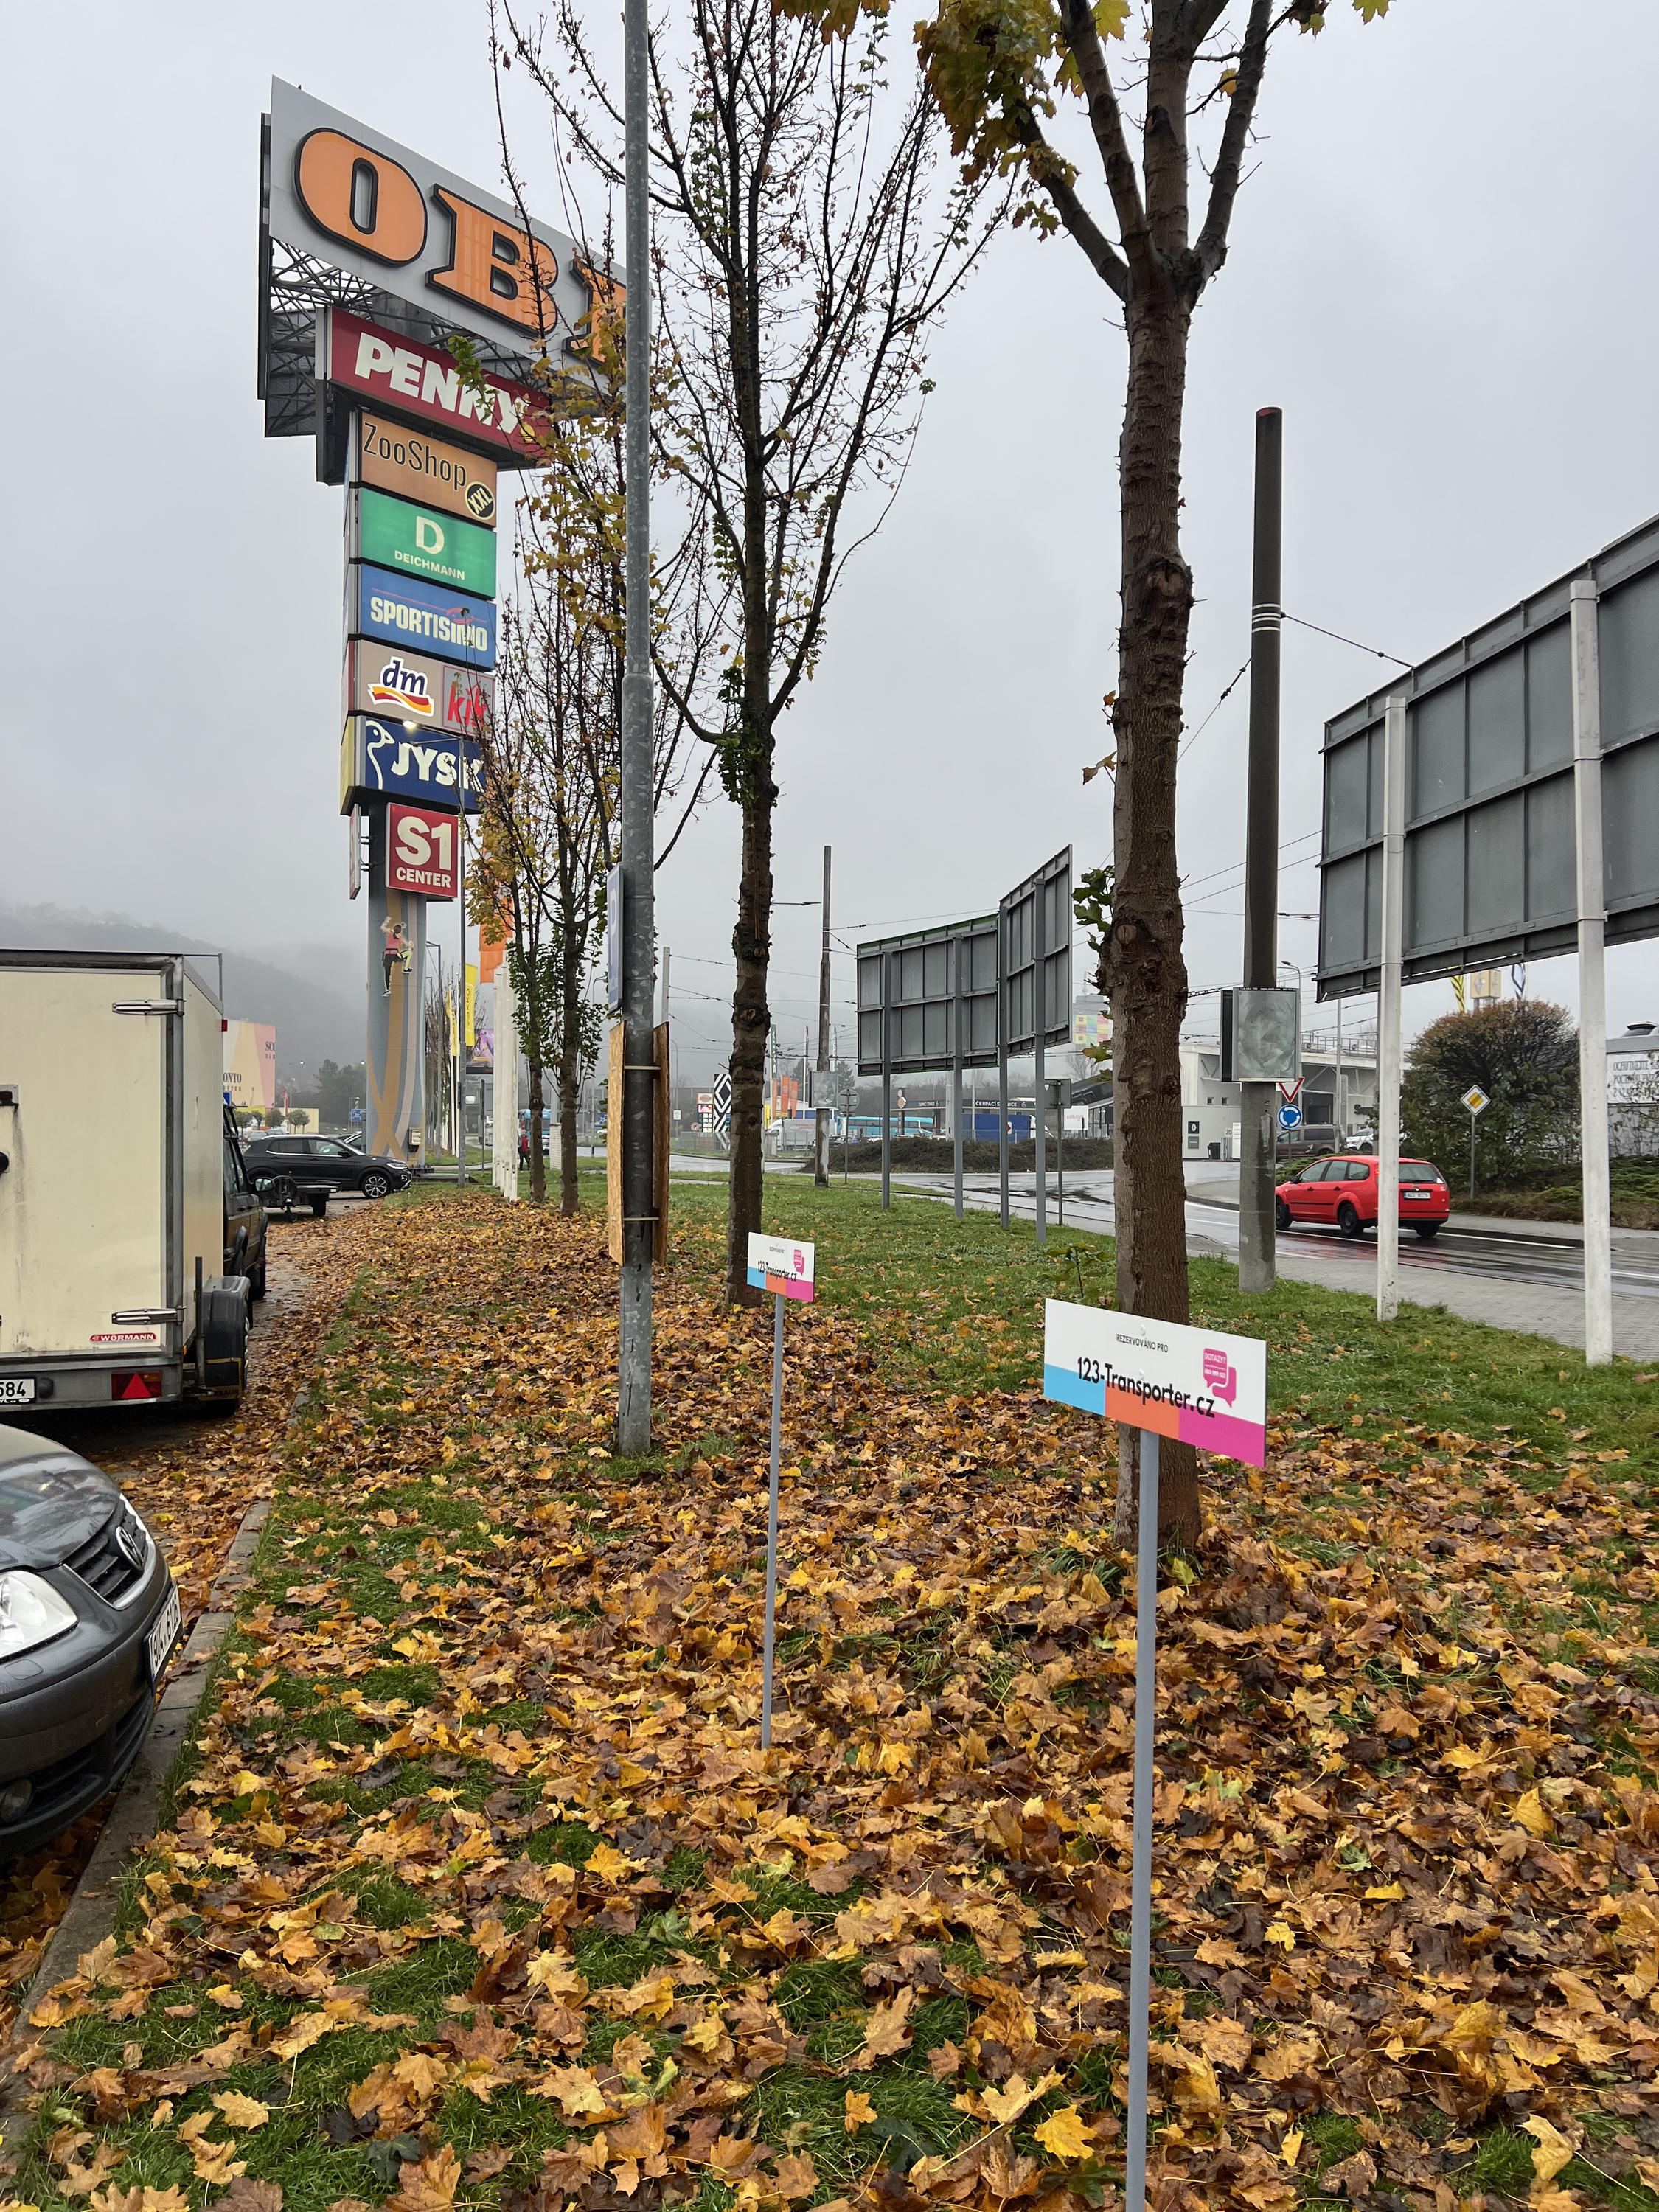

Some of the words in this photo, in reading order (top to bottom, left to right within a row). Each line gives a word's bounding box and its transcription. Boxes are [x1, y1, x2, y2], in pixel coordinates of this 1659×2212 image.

[355, 333, 529, 434] PENNY
[364, 422, 466, 490] ZooShop
[467, 487, 493, 515] XXL
[415, 515, 445, 554] D
[394, 550, 465, 581] DEICHMANN
[370, 597, 487, 652] SPORTISIMO
[382, 660, 425, 695] dm
[391, 742, 485, 793] JYSK
[395, 816, 452, 871] S1
[396, 868, 451, 888] CENTER
[223, 1072, 242, 1083] ONTO
[1116, 1334, 1155, 1349] REZERVOVÁNO
[1158, 1343, 1168, 1352] PRO
[1078, 1357, 1214, 1417] 123-Transporter.cz
